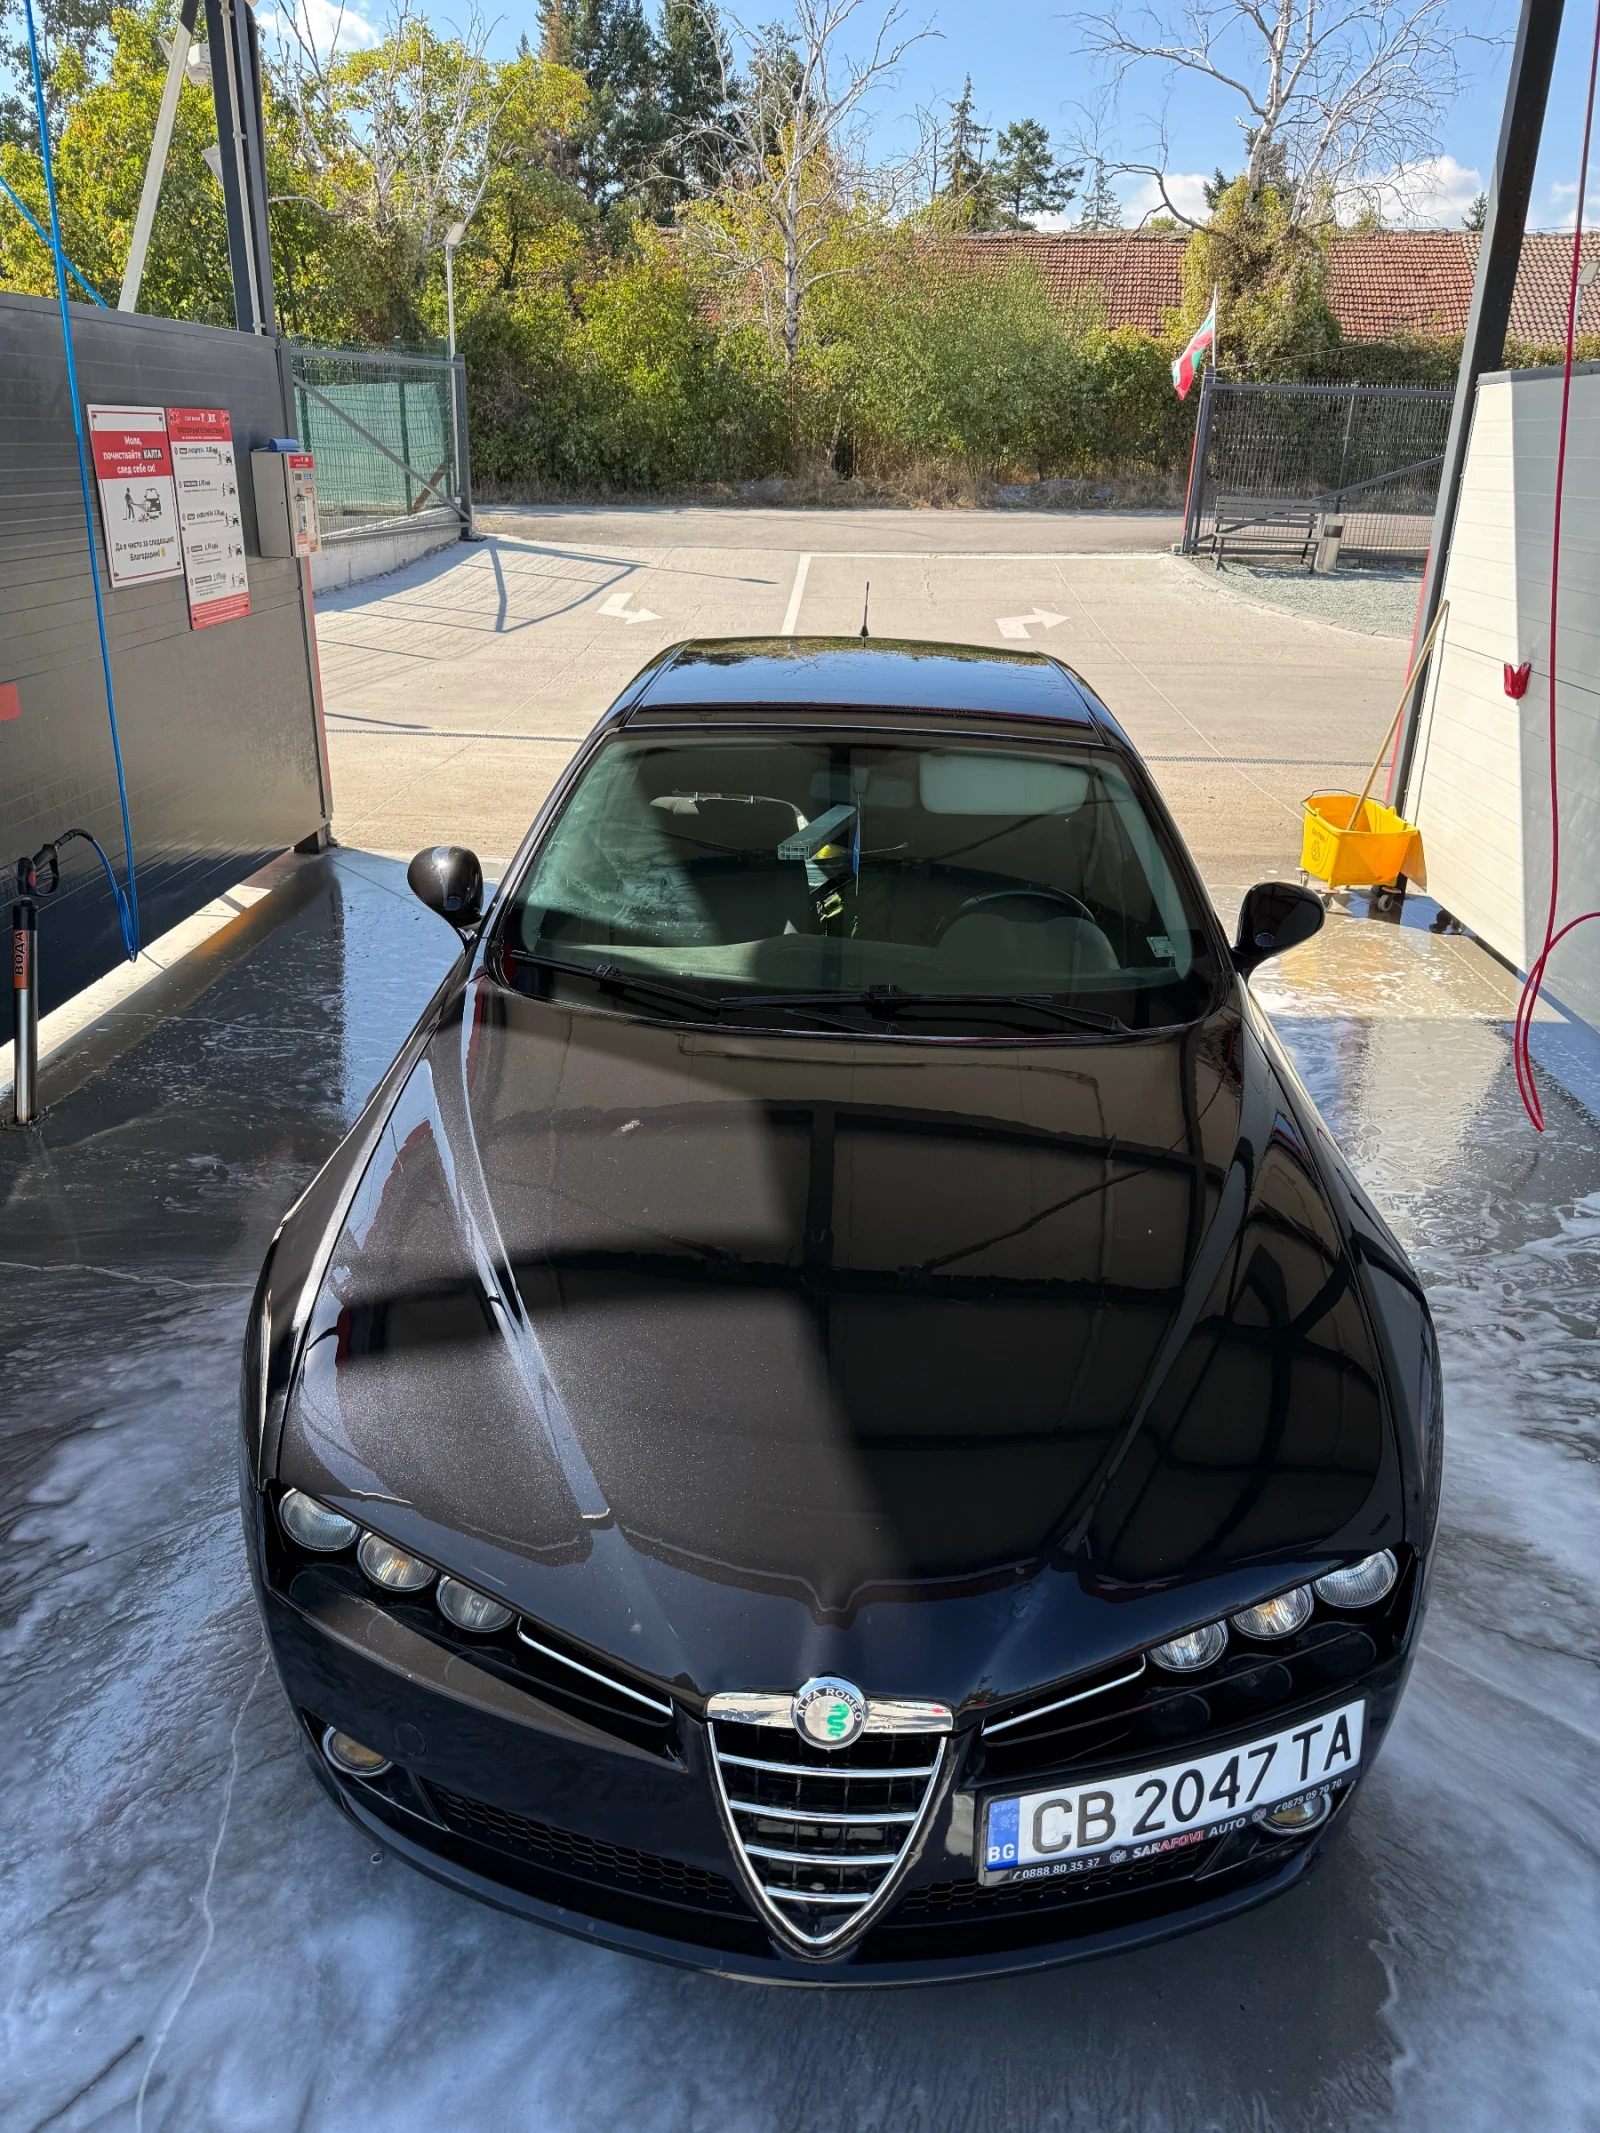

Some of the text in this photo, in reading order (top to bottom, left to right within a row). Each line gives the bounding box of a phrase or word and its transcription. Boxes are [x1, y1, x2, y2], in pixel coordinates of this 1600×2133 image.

[124, 436, 142, 446] Моля,
[103, 449, 162, 460] почиствайте КАЛТА
[117, 465, 132, 474] след
[133, 463, 146, 473] себе
[115, 542, 123, 552] Да
[127, 541, 142, 549] чисто
[15, 931, 26, 975] ВОДА
[797, 1688, 862, 1721] ALFA ROMEO
[1132, 1742, 1278, 1836] 2047
[1292, 1713, 1352, 1782] TA
[1022, 1779, 1342, 1879] 0888 80 35 37 SARAFOVI AUTO 0879 09 70 70
[988, 1845, 1015, 1862] BG
